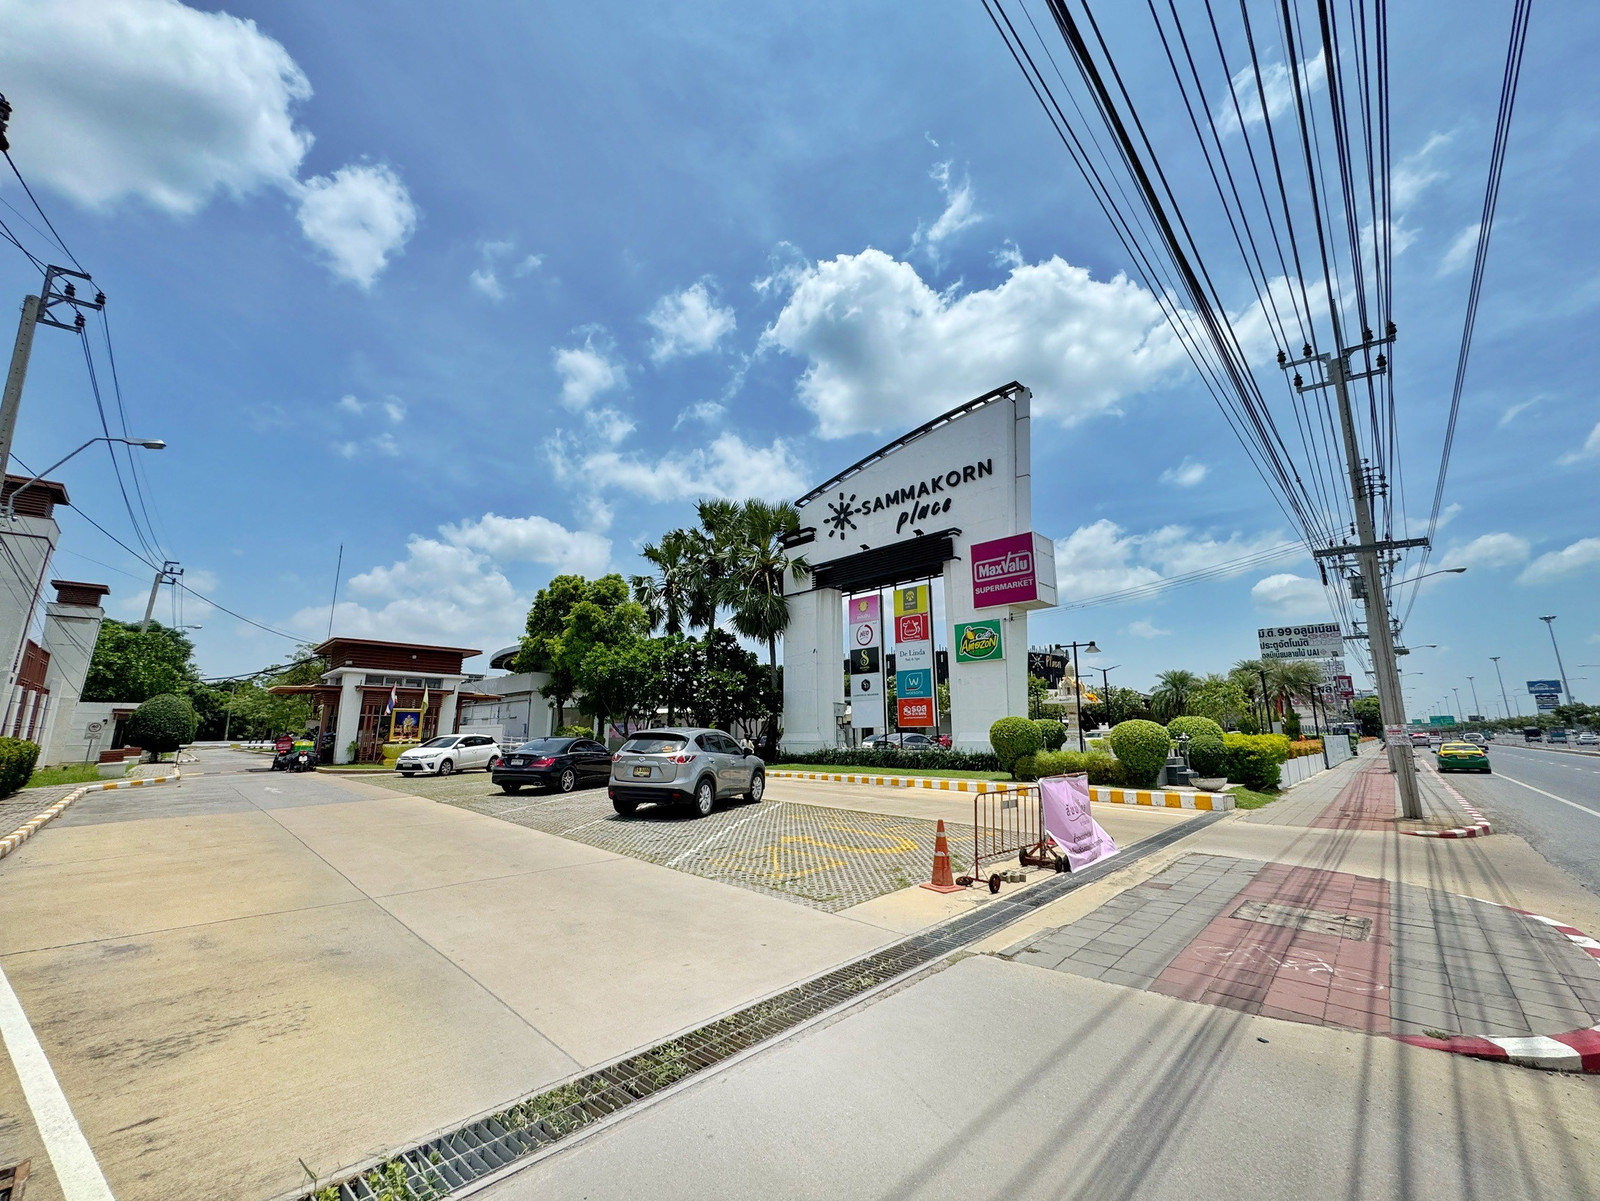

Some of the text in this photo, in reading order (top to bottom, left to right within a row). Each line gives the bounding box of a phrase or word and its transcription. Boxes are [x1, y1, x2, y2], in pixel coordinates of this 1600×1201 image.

[861, 458, 993, 516] SAMMAKORN
[896, 497, 952, 534] place
[978, 551, 1028, 578] MaxValu
[975, 579, 1034, 594] SUPERMARKET
[1277, 627, 1292, 637] 99
[1293, 623, 1340, 638] อลูมิเนียม
[1260, 638, 1309, 650] ประตูอัตโนมัติ
[899, 648, 926, 658] De Linda
